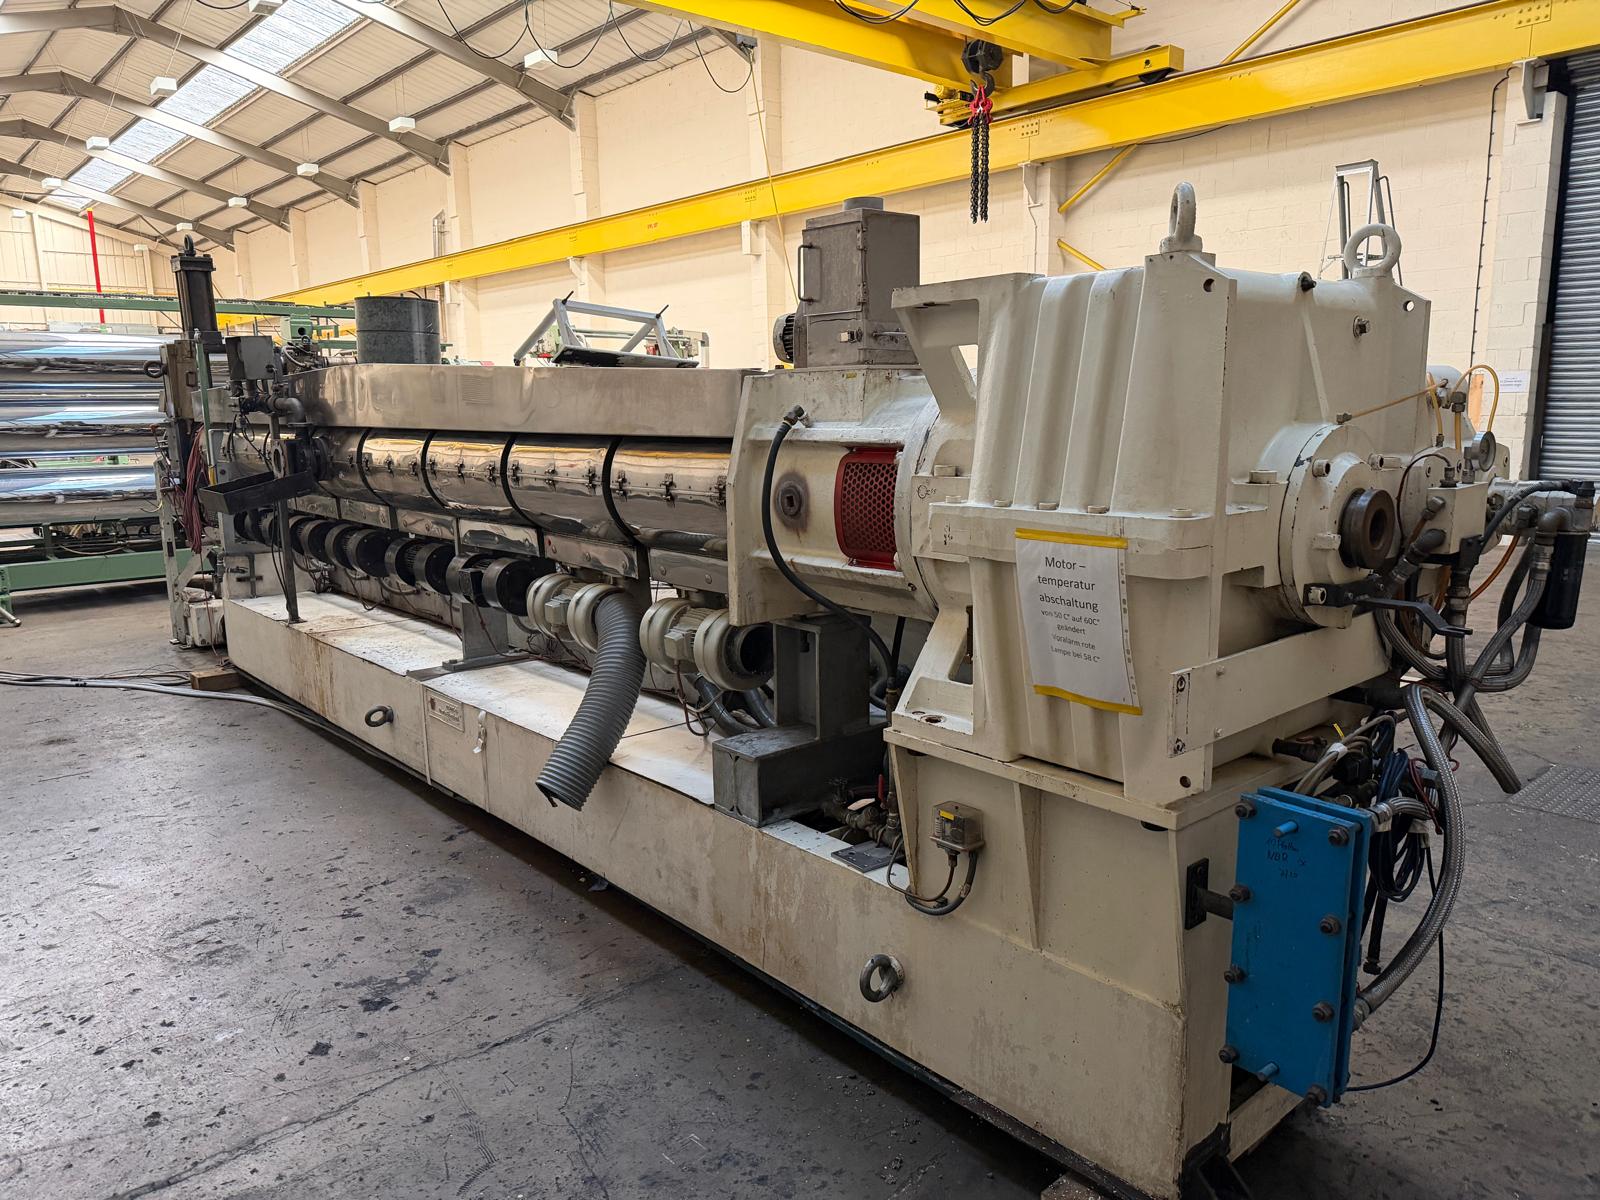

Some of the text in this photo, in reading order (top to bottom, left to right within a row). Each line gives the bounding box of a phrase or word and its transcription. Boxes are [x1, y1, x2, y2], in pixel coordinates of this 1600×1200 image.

[1045, 556, 1076, 570] Motor
[1037, 574, 1095, 591] temperatur
[1039, 592, 1099, 613] abschaltung
[1054, 611, 1062, 619] 50
[1051, 633, 1096, 650] Voralarm rote
[1050, 645, 1071, 657] Lampe
[1072, 650, 1083, 659] bei
[1083, 653, 1092, 661] 58
